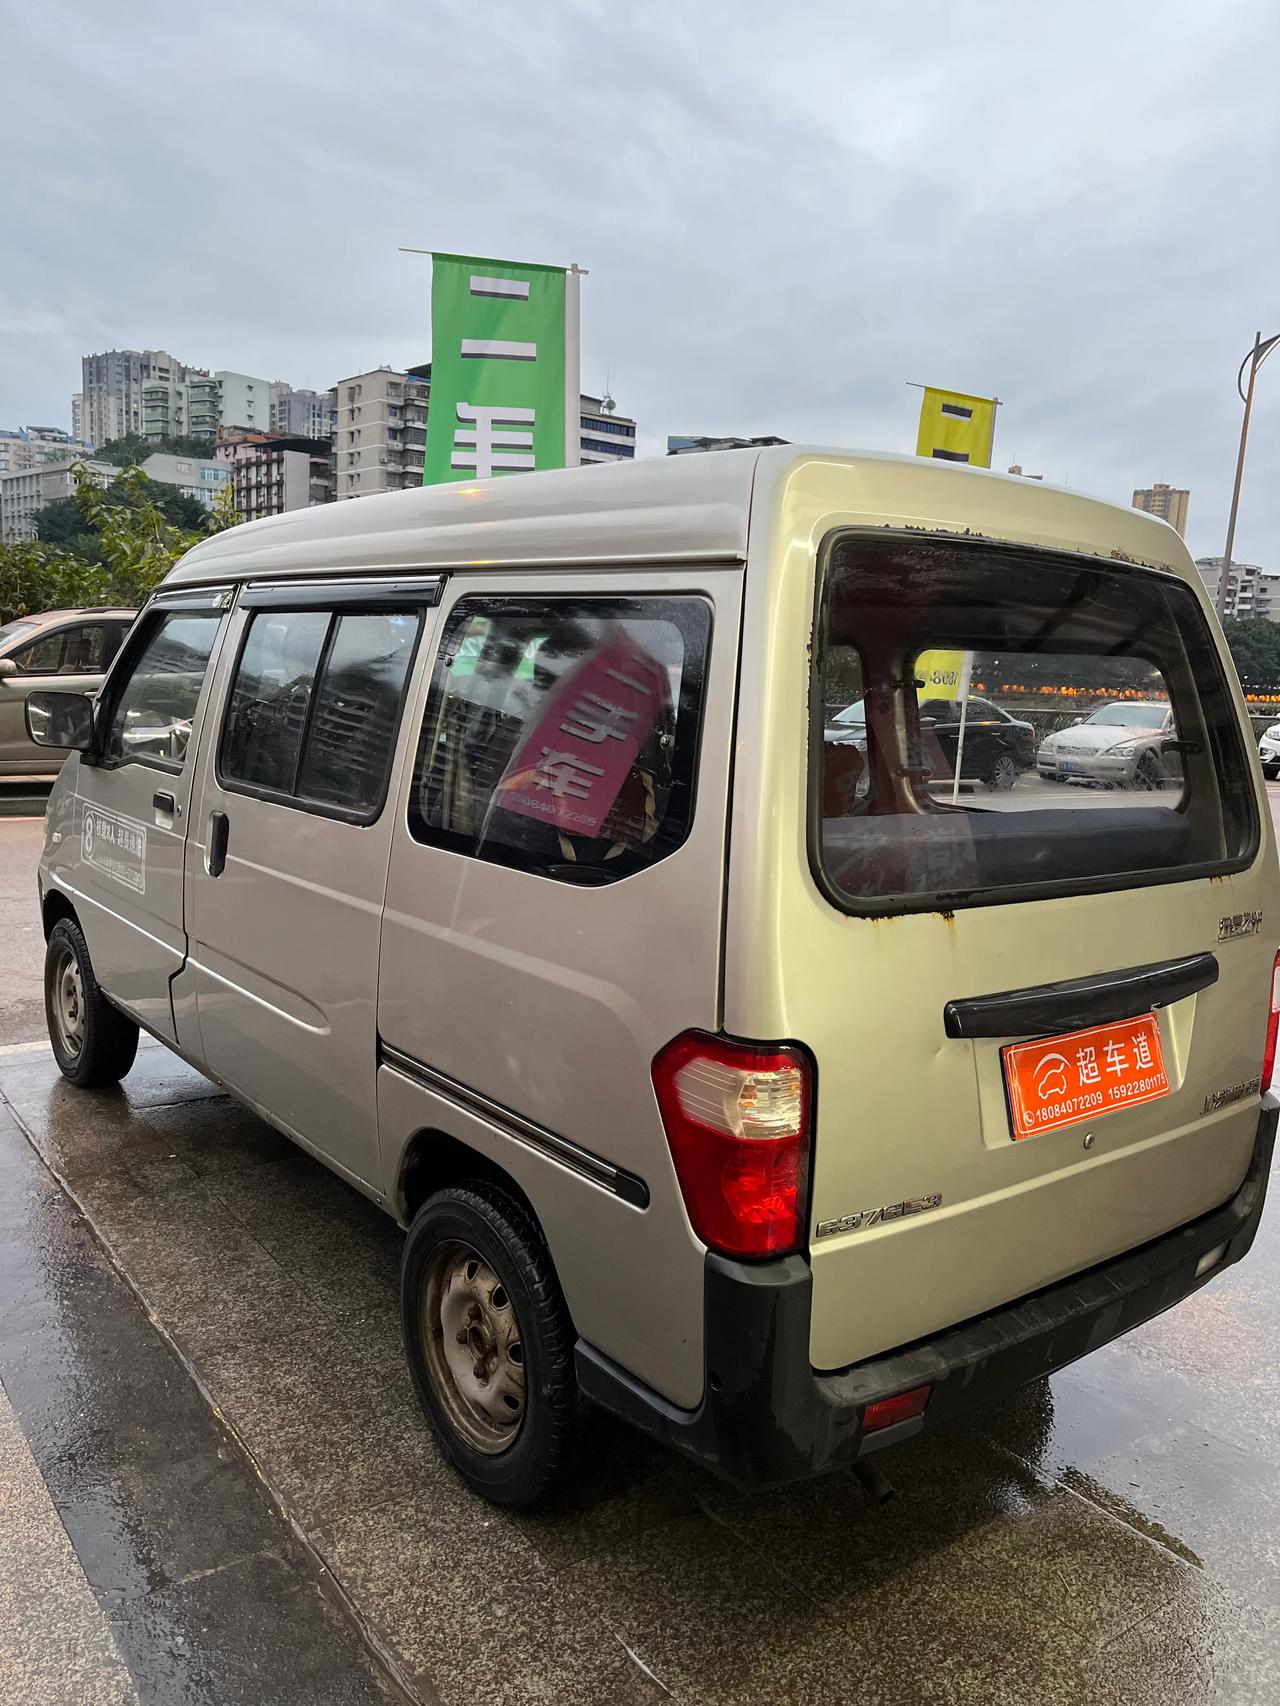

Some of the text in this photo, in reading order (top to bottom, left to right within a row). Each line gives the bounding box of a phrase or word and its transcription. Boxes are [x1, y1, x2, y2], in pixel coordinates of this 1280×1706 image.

[1076, 1031, 1154, 1087] 超车道
[1035, 1071, 1166, 1122] 18084072209 15922801175
